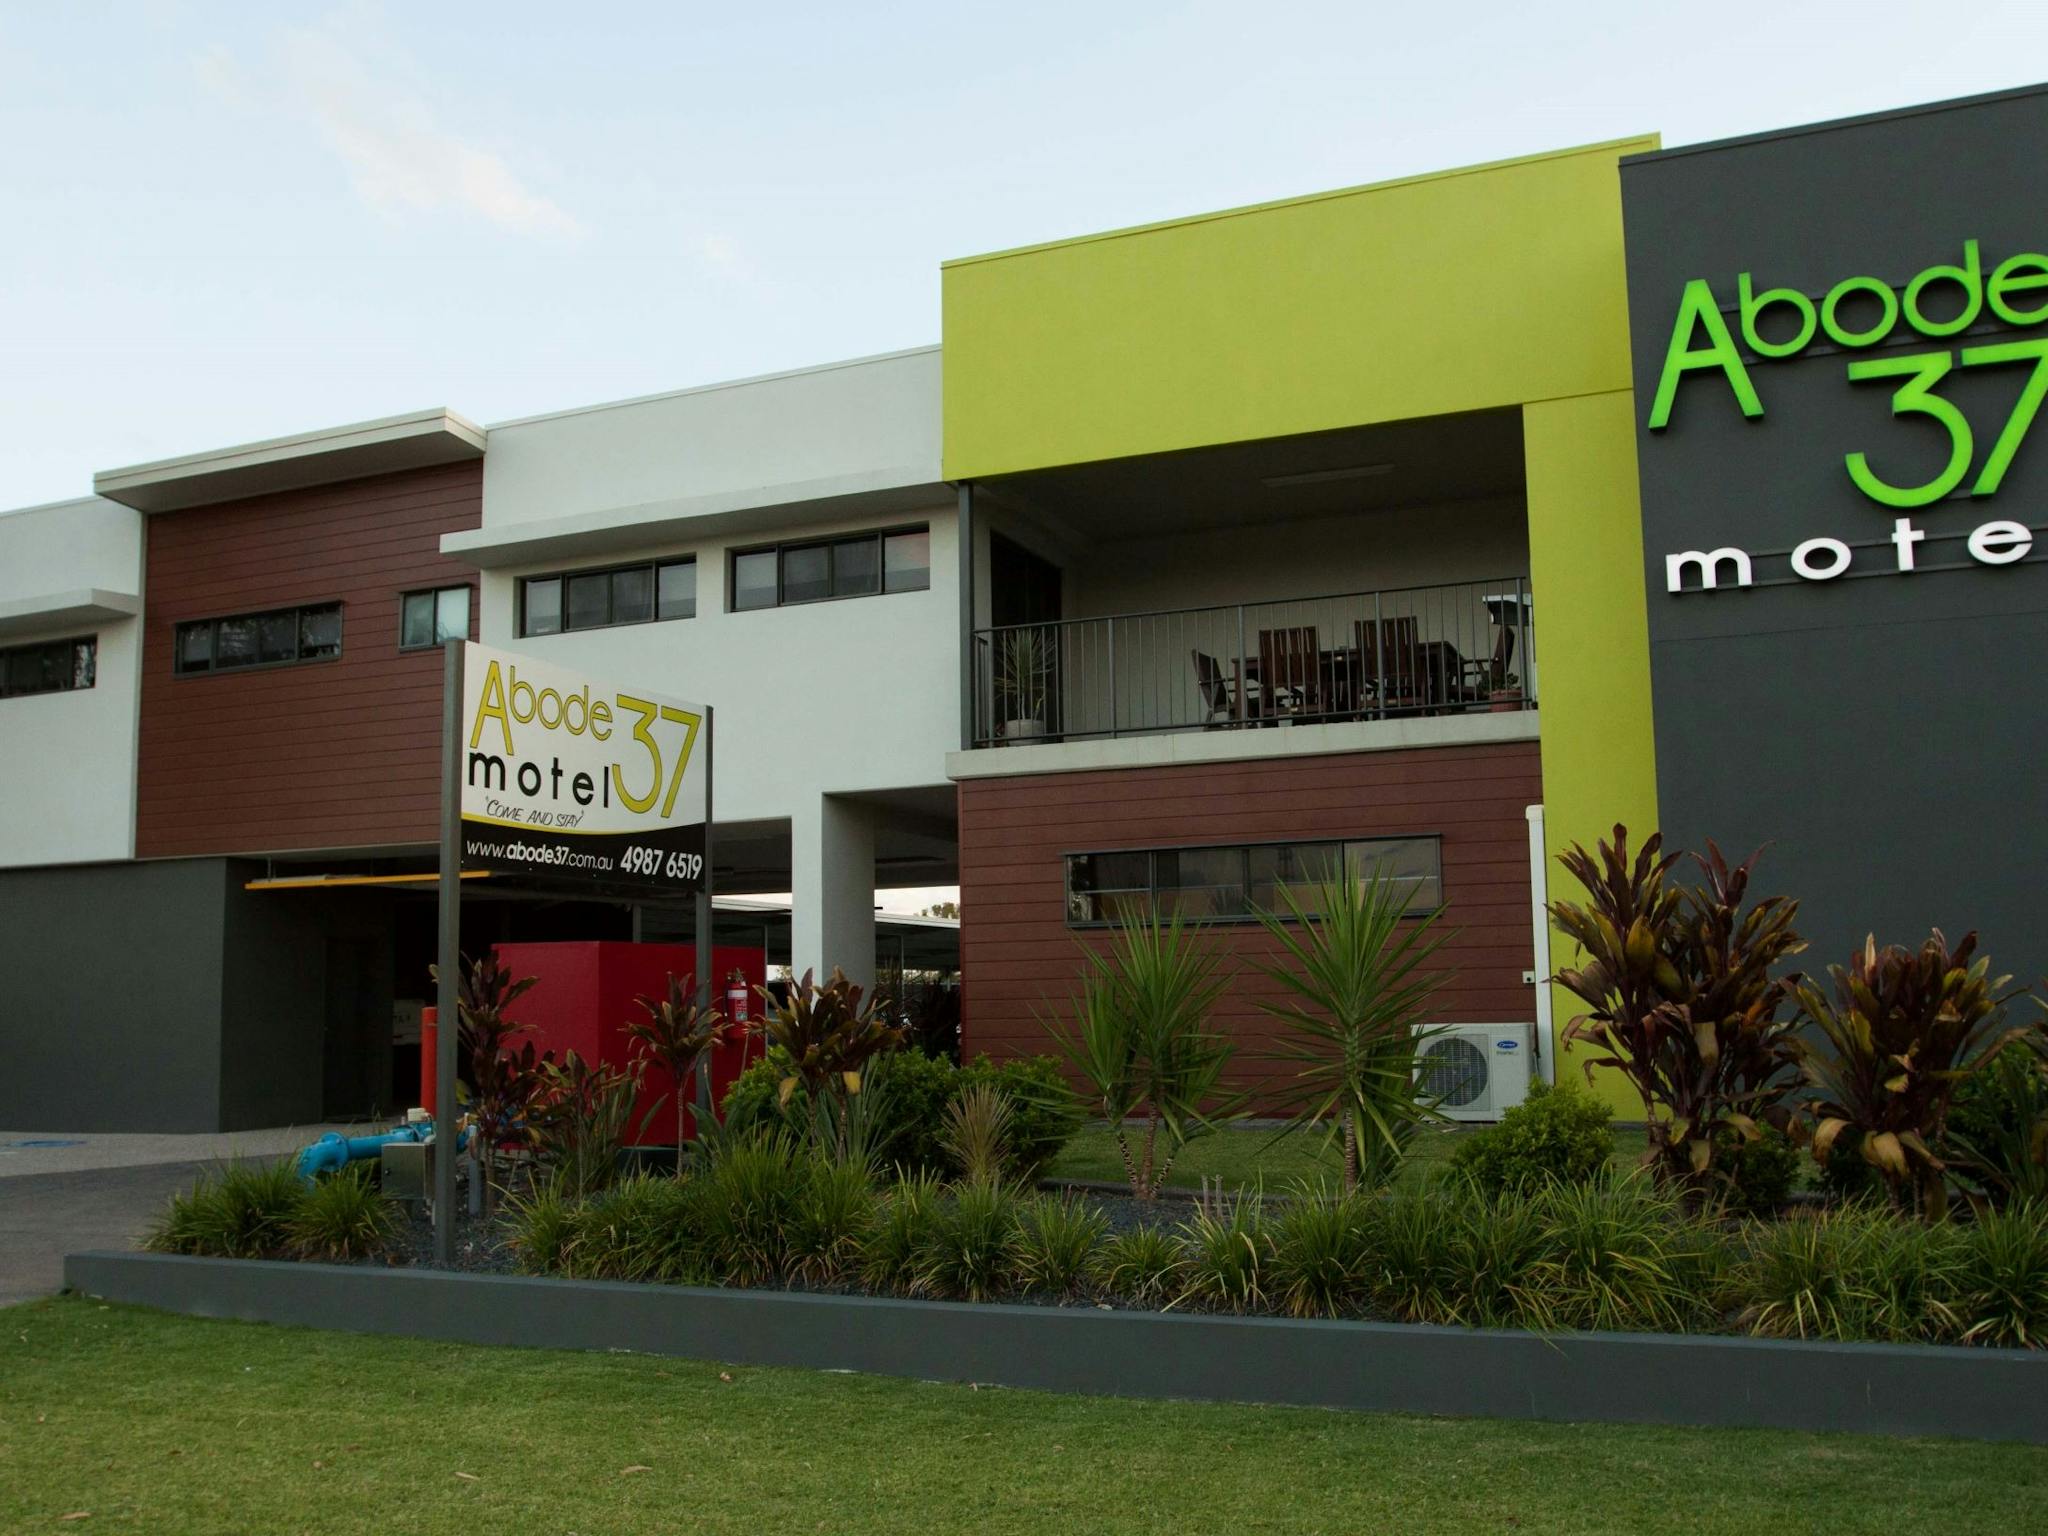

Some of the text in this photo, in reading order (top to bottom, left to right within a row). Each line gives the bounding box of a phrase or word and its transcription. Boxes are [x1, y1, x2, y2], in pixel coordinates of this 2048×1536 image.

[1648, 239, 2048, 432] Abode
[1845, 338, 2048, 509] 37
[468, 752, 609, 809] motel
[470, 660, 702, 819] Abode 37
[466, 840, 703, 880] www.abode37.com.au 4987 6519
[526, 810, 553, 826] AND
